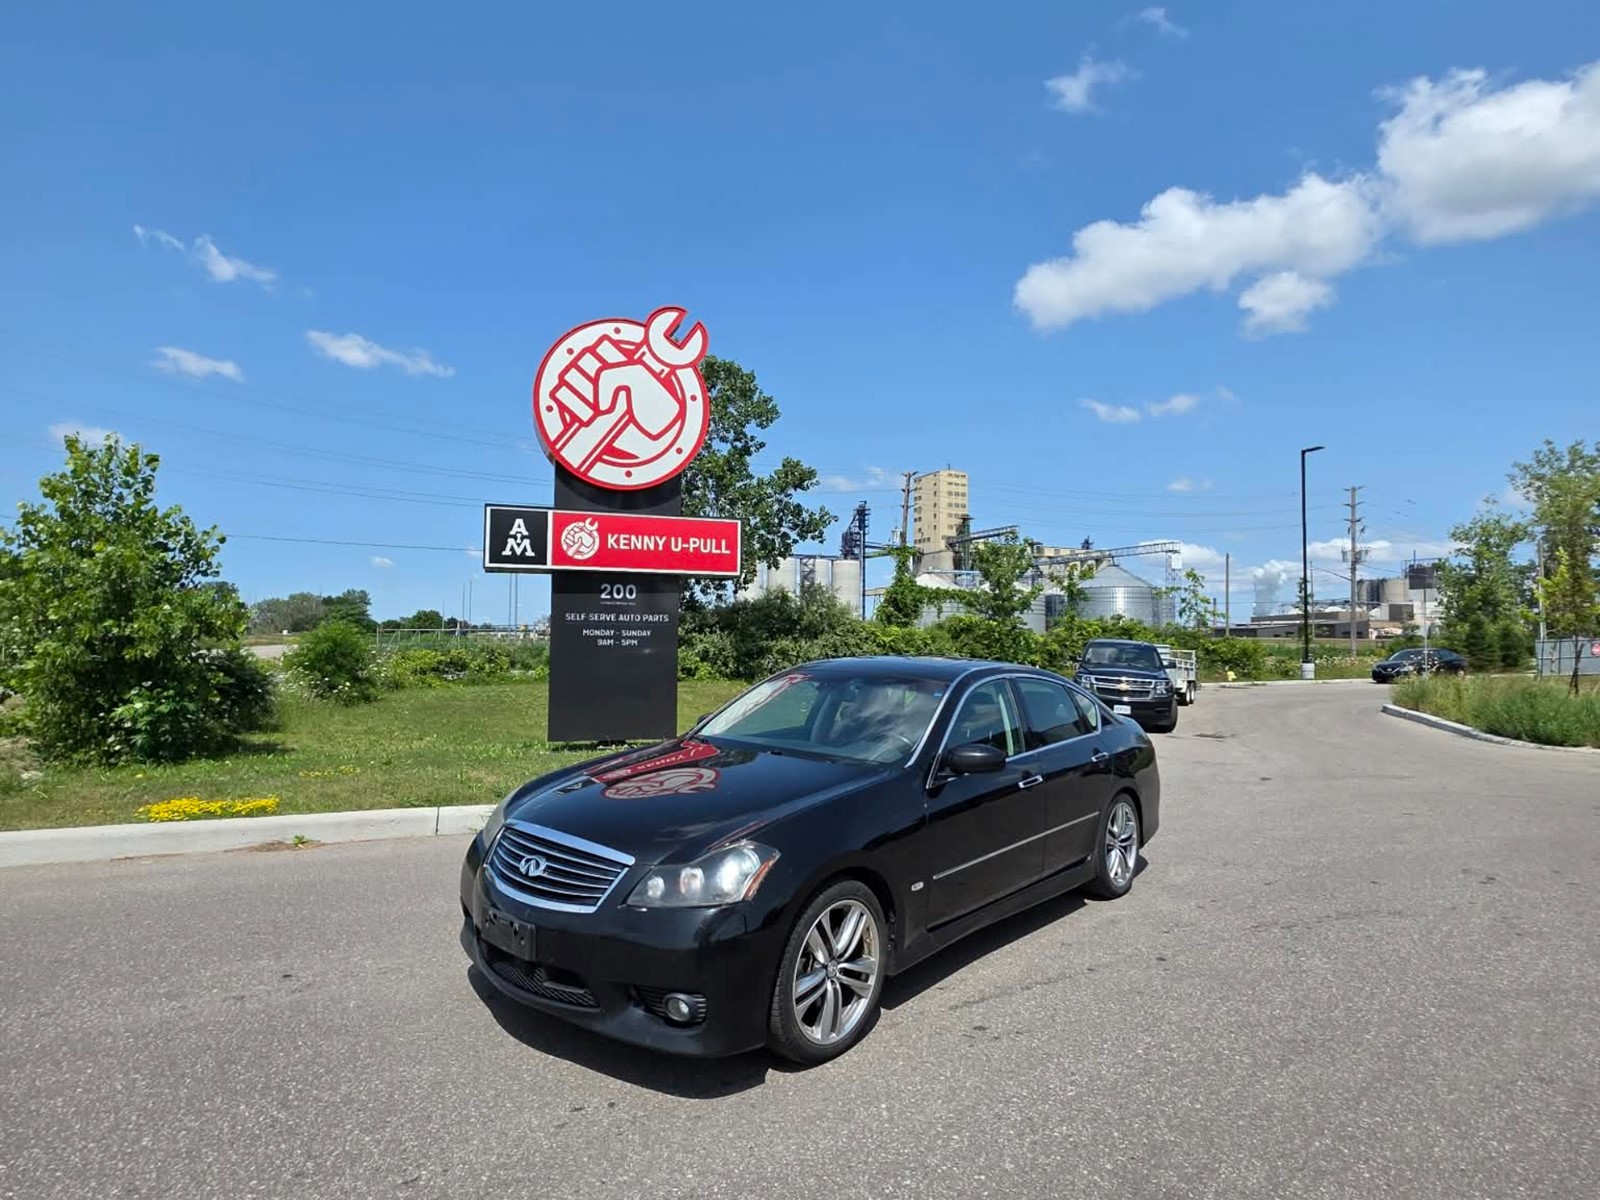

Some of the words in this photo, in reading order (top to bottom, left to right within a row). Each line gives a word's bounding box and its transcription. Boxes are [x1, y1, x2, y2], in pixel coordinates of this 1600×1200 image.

[607, 533, 666, 551] KENNY
[670, 536, 731, 555] U-PULL
[600, 584, 636, 599] 200
[618, 614, 641, 622] AUTO
[642, 614, 669, 622] PARTS
